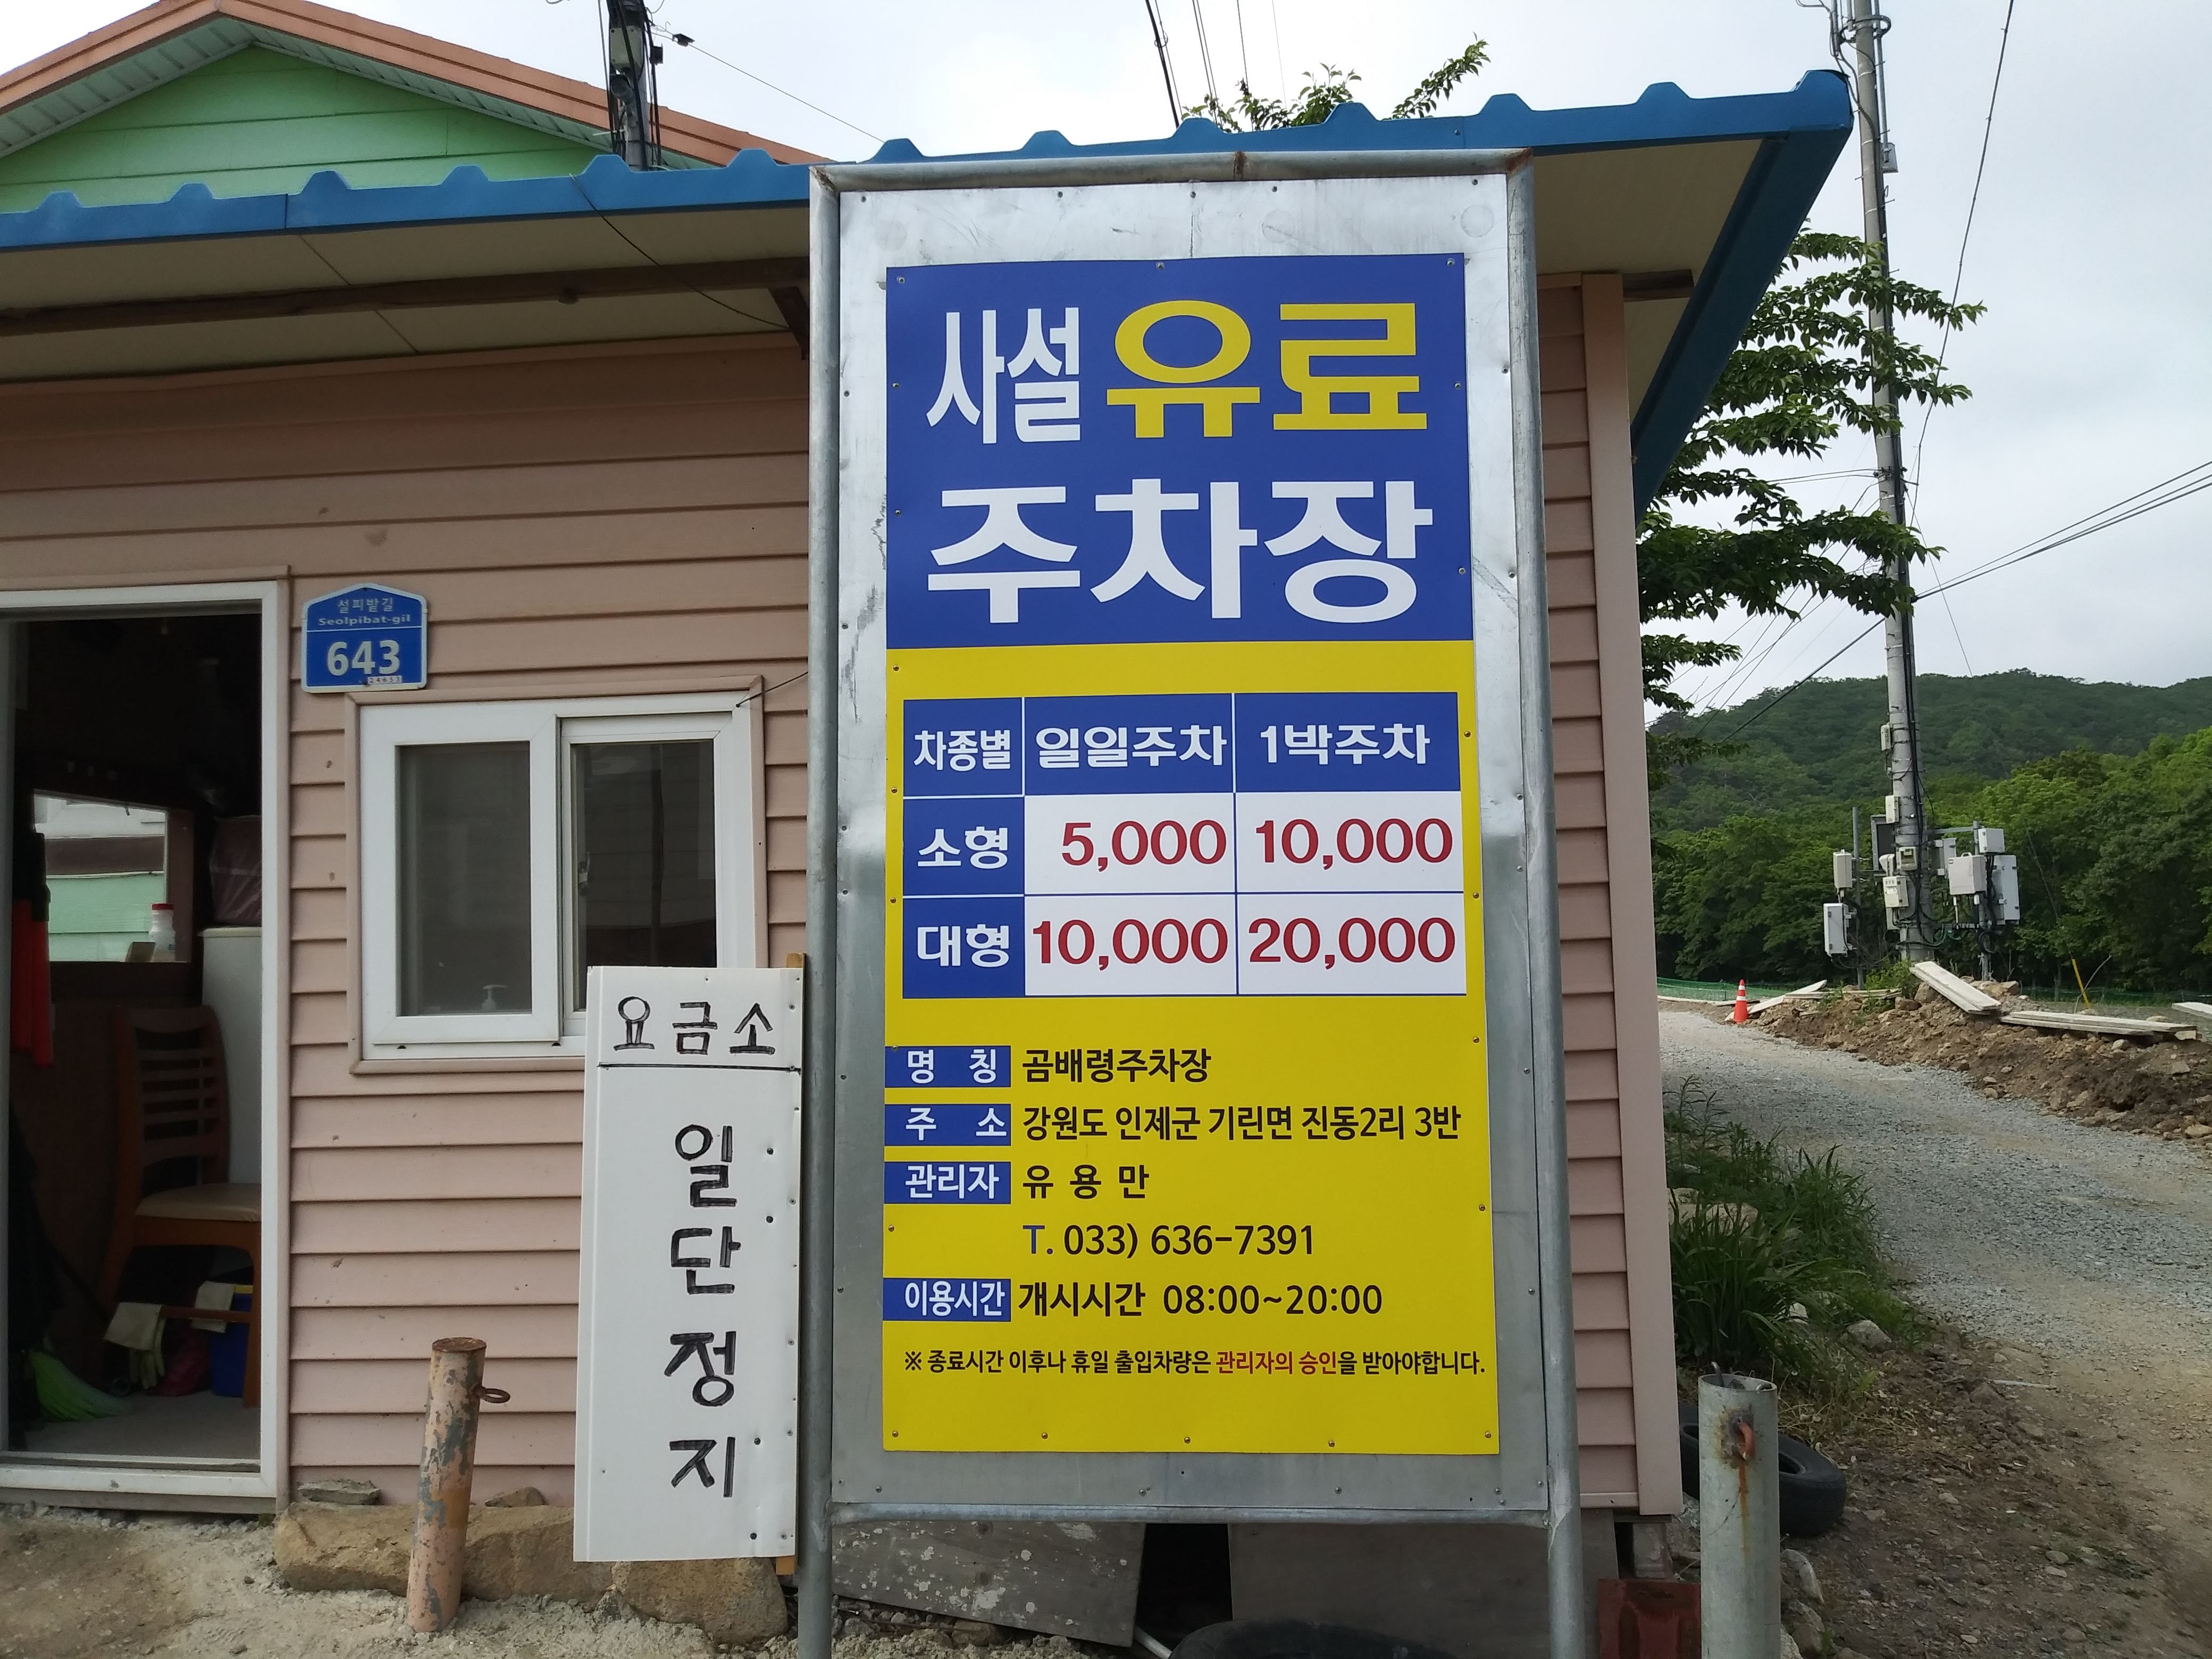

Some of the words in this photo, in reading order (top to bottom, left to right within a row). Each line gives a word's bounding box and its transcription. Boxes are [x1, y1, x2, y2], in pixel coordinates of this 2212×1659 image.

[926, 307, 1081, 445] 사설
[1108, 301, 1428, 438] 유료
[928, 479, 1434, 624] 주차장
[319, 614, 411, 626] Seolpibat-gil
[338, 597, 394, 614] 설피밭길
[327, 639, 400, 676] 643
[914, 730, 1011, 772] 차종별
[1036, 725, 1228, 769] 일일주차
[1261, 724, 1431, 765] 1박주차
[918, 826, 1008, 869] 소형
[1063, 820, 1227, 871] 5,000
[1257, 819, 1453, 869] 10,000
[918, 924, 1010, 968] 대형
[1034, 919, 1228, 970] 10,000
[1250, 918, 1455, 969] 20,000
[1023, 1049, 1212, 1084] 곰배령주차장
[1023, 1107, 1108, 1142] 강원도
[1116, 1107, 1201, 1141] 인제군
[1209, 1106, 1293, 1141] 기린면
[1302, 1106, 1404, 1141] 진동2리
[1415, 1105, 1462, 1140] 3반
[906, 1164, 1000, 1200] 관리자
[906, 1281, 1006, 1317] 이용시간
[1019, 1282, 1146, 1318] 개시시간
[928, 1350, 1004, 1374] 종료시간
[1010, 1350, 1067, 1375] 이후나
[1071, 1351, 1109, 1375] 휴일
[1115, 1351, 1212, 1375] 출입차량은
[1216, 1351, 1293, 1376] 관리자의
[1298, 1352, 1356, 1376] 승인을
[1363, 1351, 1486, 1376] 받아야합니다.
